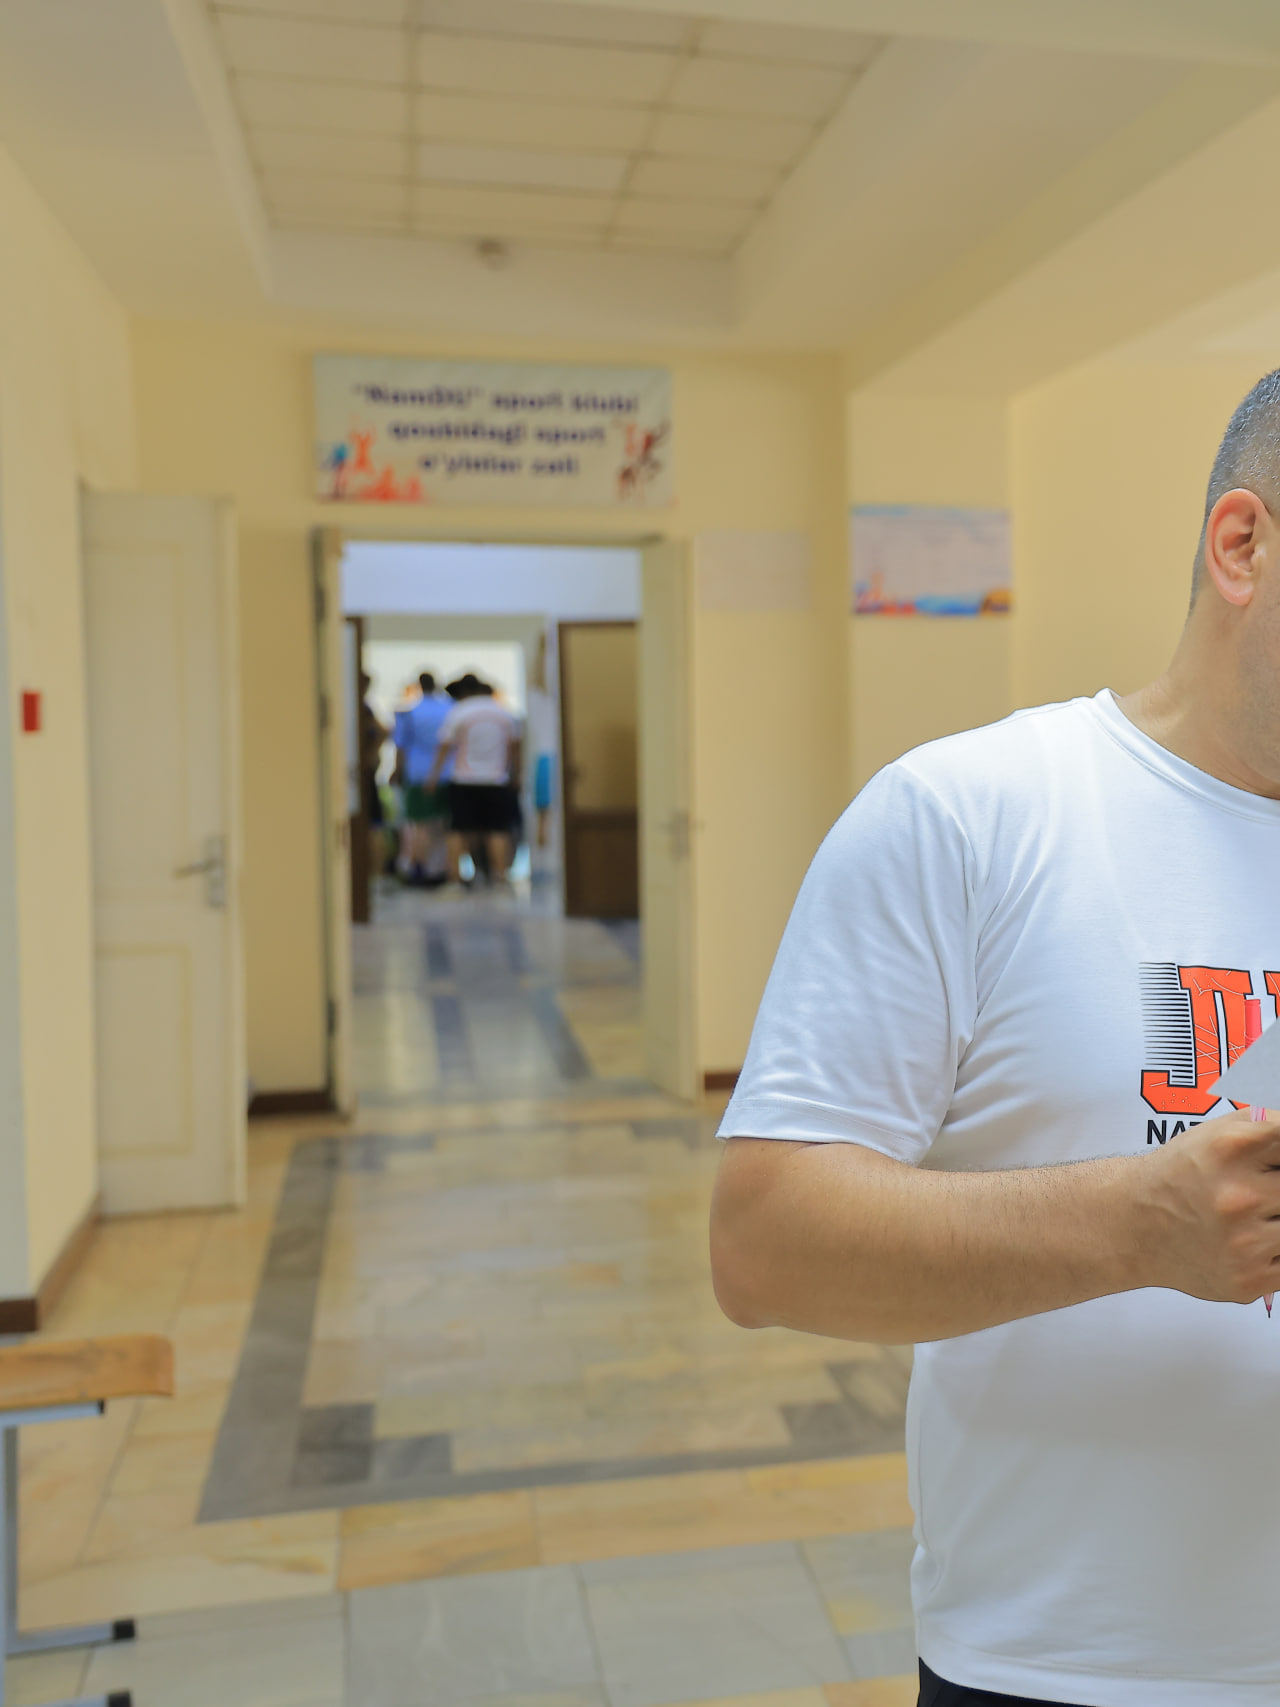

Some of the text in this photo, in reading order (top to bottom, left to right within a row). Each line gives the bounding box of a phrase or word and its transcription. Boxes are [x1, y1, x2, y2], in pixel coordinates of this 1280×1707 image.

[491, 391, 564, 413] sport
[535, 424, 606, 446] sport
[1146, 1119, 1204, 1145] NA
